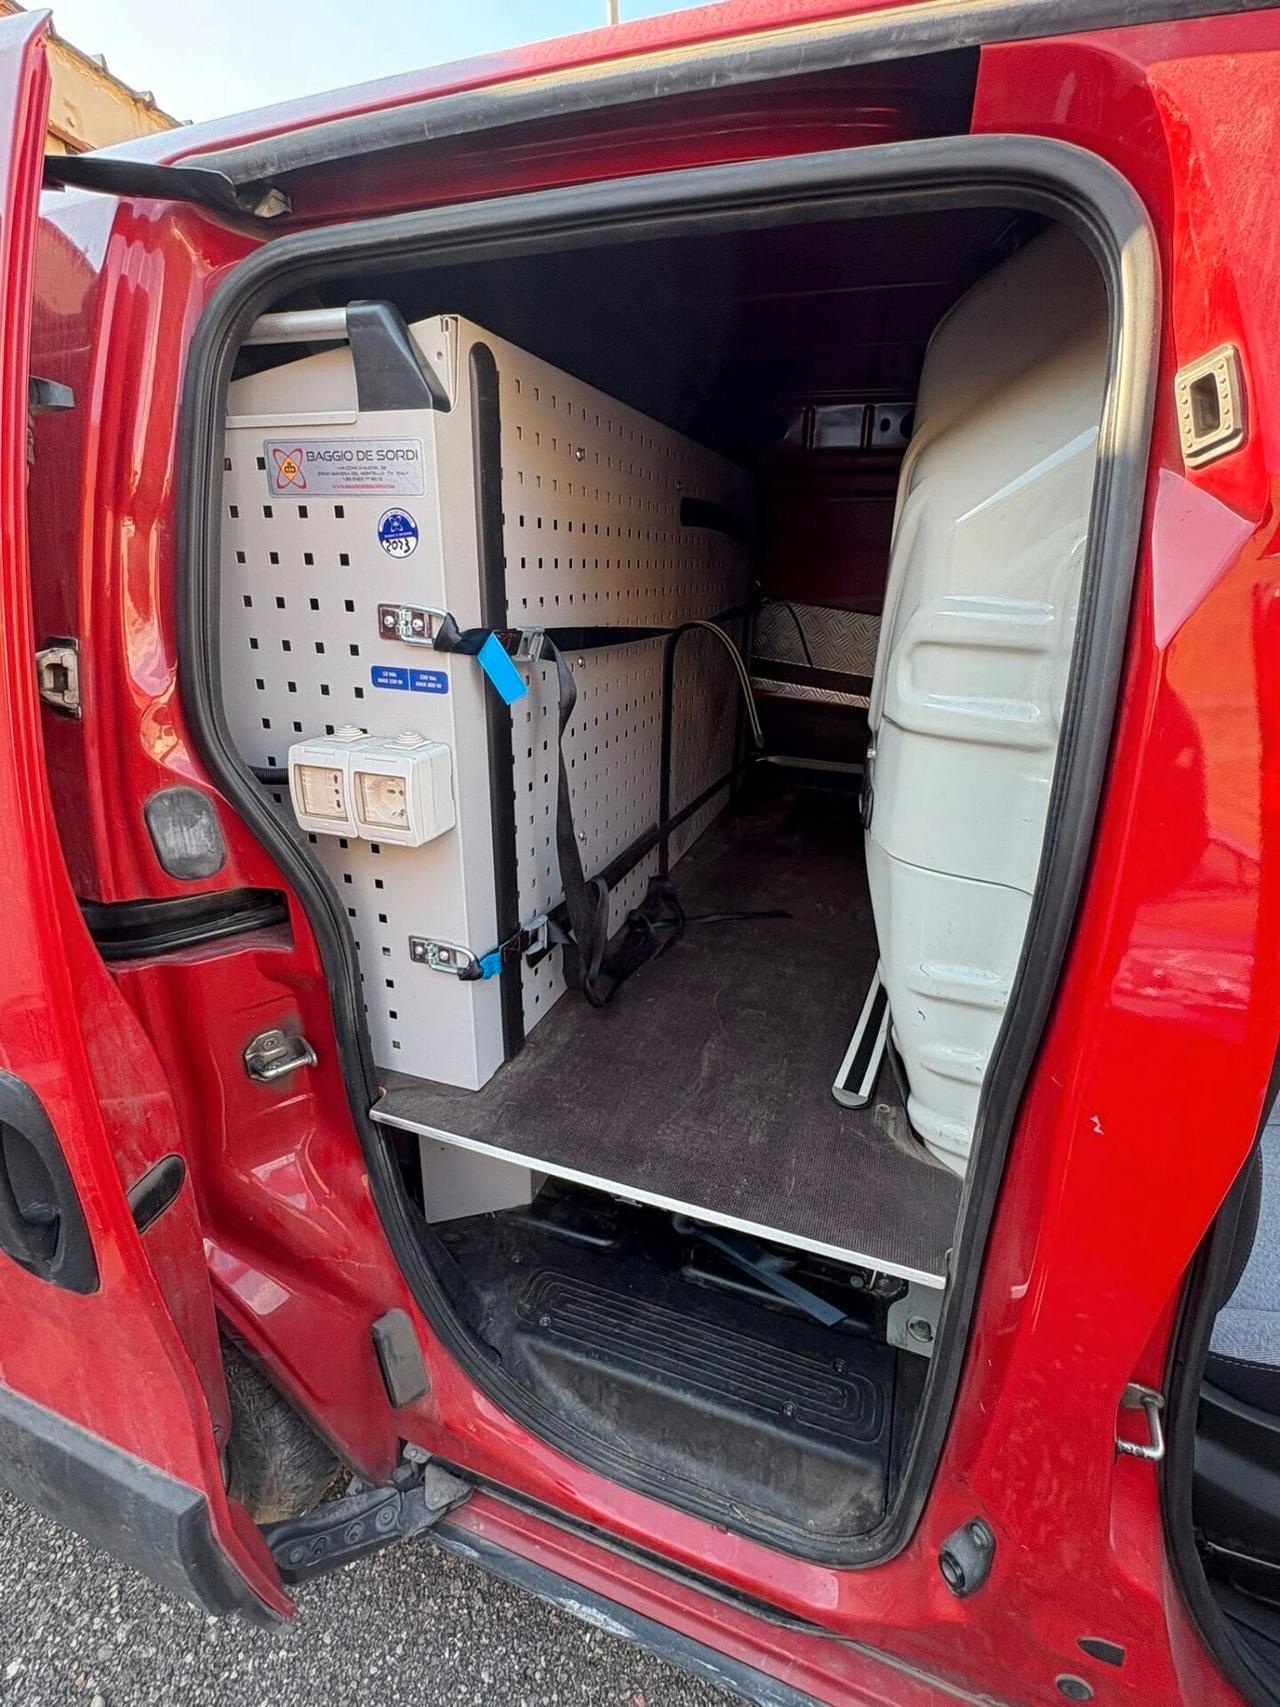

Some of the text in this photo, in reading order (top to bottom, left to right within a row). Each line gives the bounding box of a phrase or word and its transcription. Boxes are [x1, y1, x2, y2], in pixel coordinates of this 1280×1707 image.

[306, 449, 418, 462] BAGGIO DE SORDI
